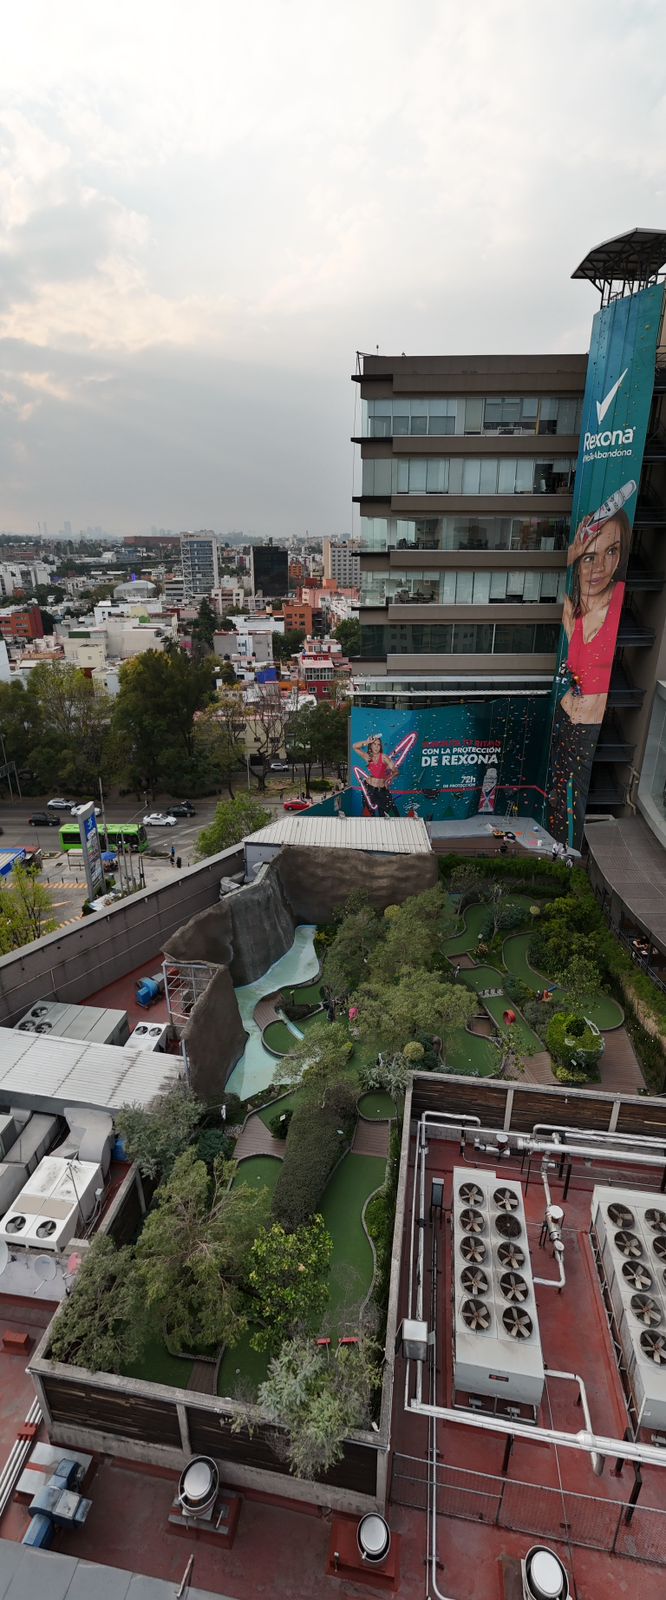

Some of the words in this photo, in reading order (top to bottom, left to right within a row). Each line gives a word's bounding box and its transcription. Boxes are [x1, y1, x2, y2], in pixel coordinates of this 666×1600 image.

[584, 428, 634, 452] Rexona
[441, 747, 451, 755] LA
[452, 746, 501, 754] PROTECCIÓN
[421, 755, 439, 767] DE
[441, 754, 498, 766] REXONA
[461, 775, 476, 784] 72h
